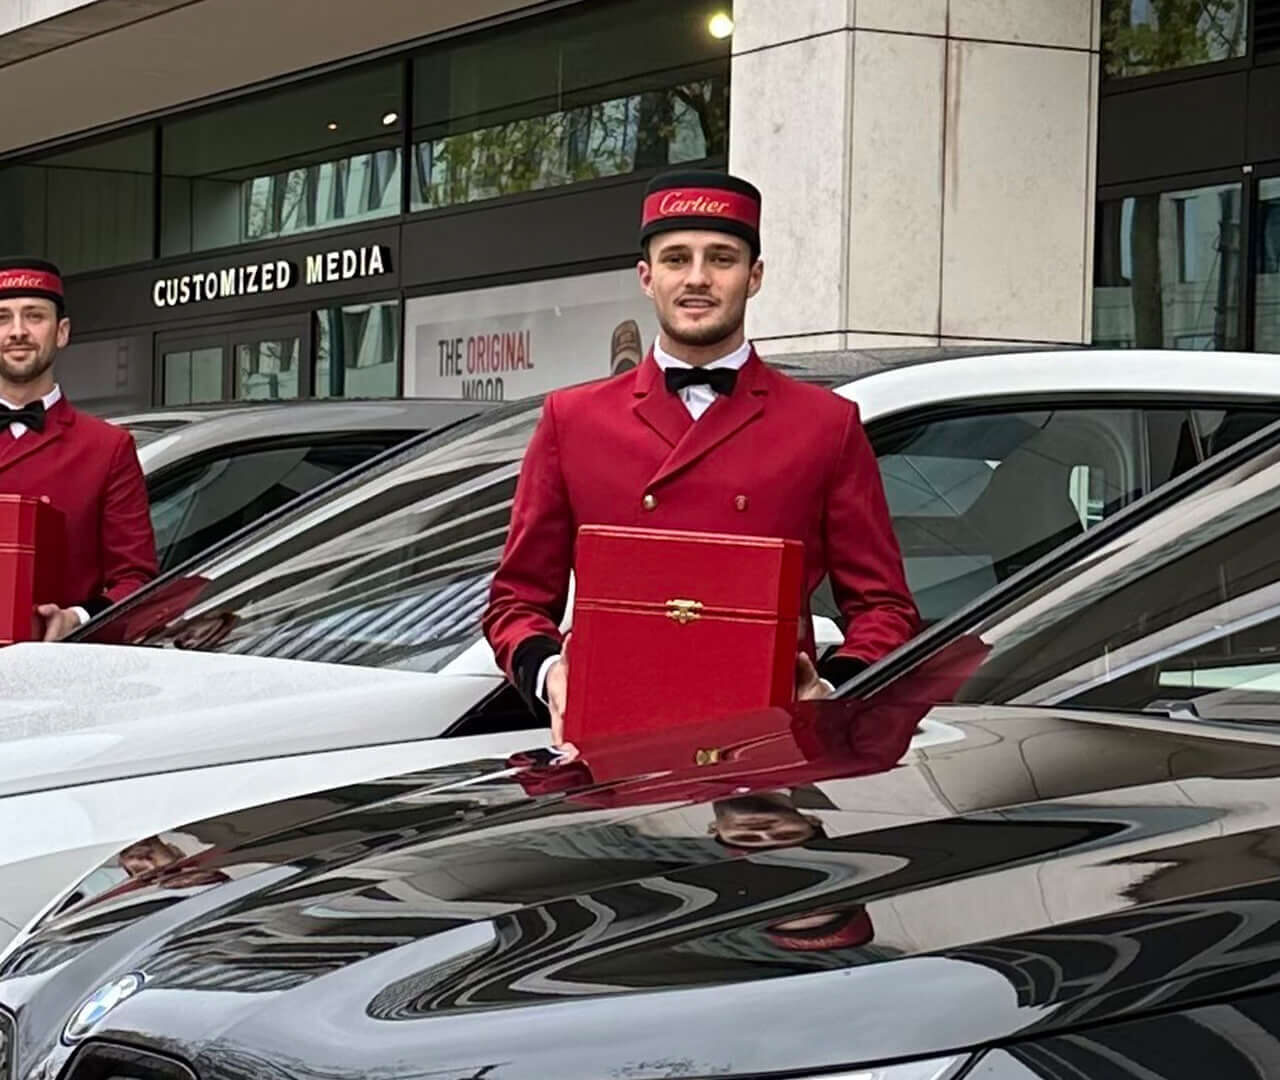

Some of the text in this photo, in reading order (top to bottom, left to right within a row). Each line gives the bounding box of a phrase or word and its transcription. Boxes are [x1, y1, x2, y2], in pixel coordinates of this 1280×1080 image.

[659, 191, 730, 215] Cartier
[153, 245, 385, 307] CUSTOMIZED MEDIA
[438, 330, 534, 377] THE ORIGINAL
